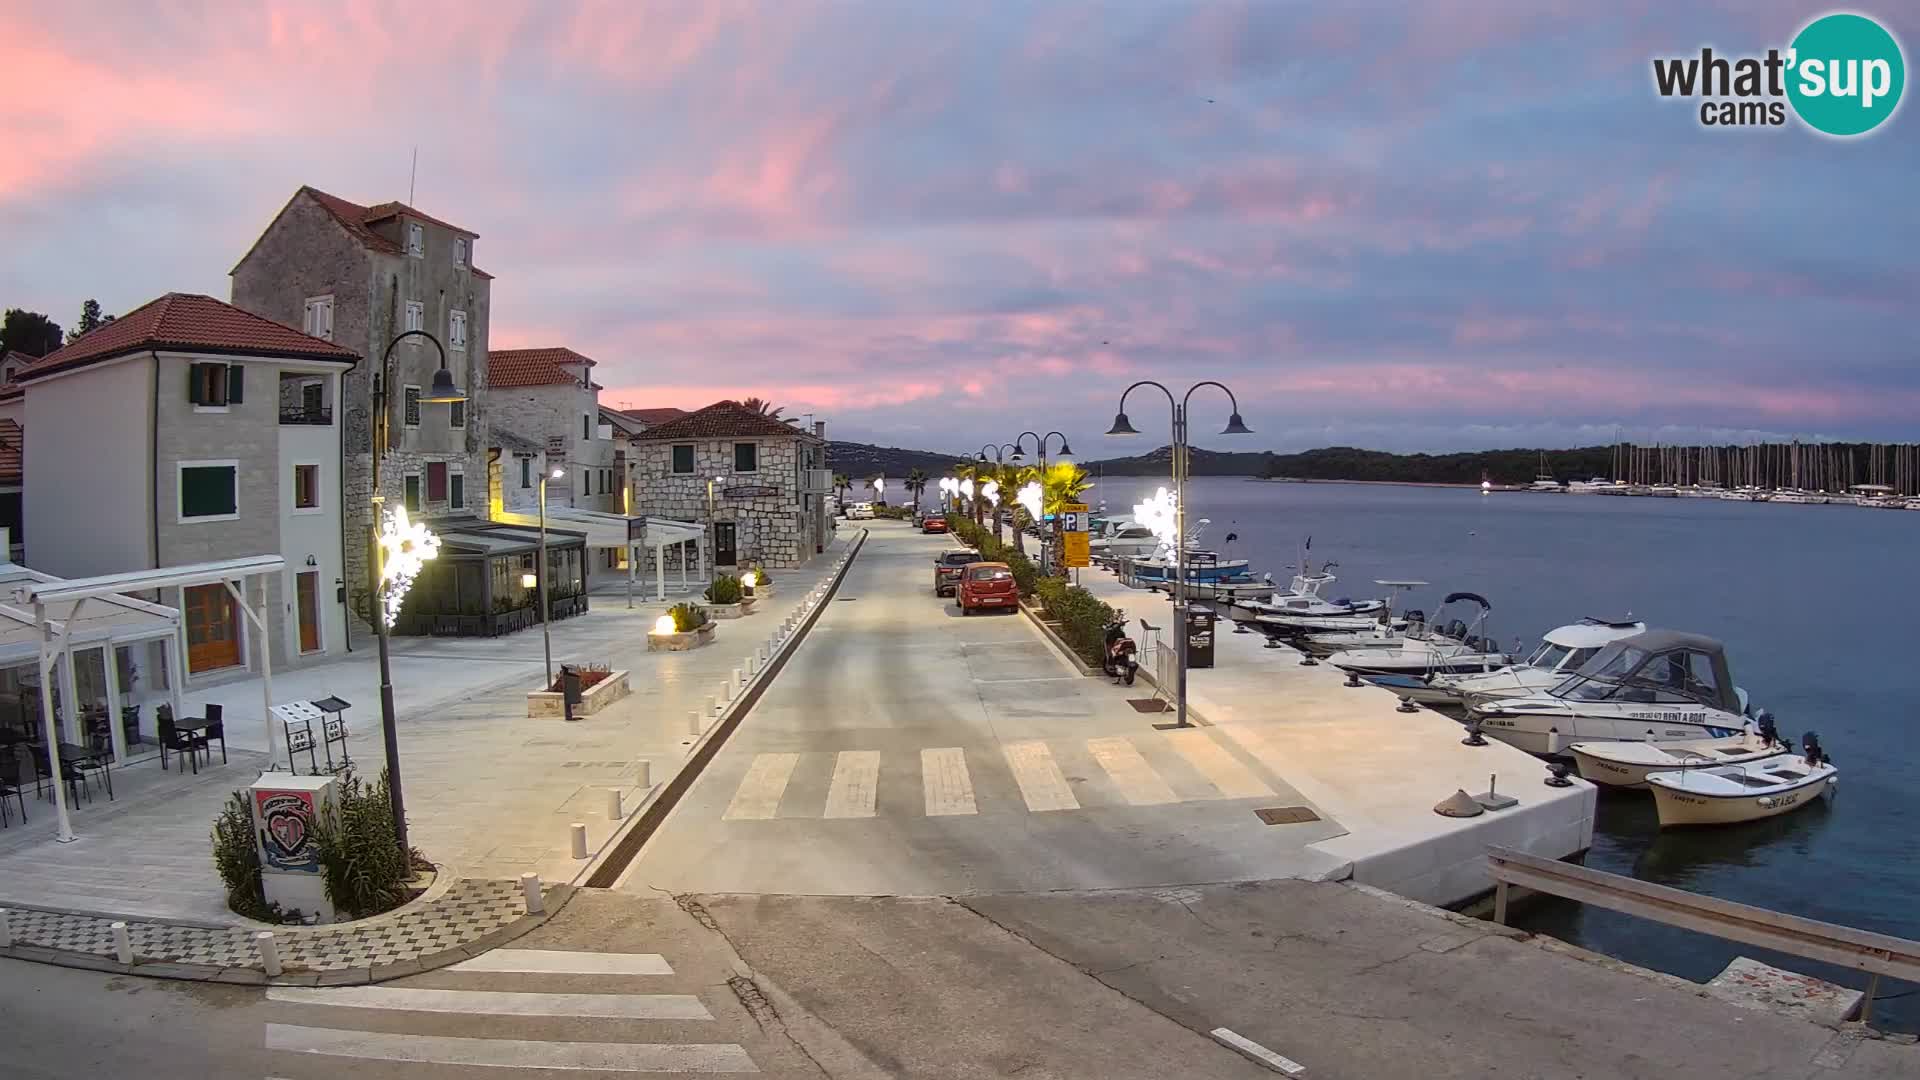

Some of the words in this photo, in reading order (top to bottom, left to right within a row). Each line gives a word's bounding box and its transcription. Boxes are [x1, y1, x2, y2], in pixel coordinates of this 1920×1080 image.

[1066, 514, 1076, 530] P
[1663, 712, 1681, 721] RENT
[1682, 713, 1688, 722] A
[1688, 713, 1707, 723] BOAT
